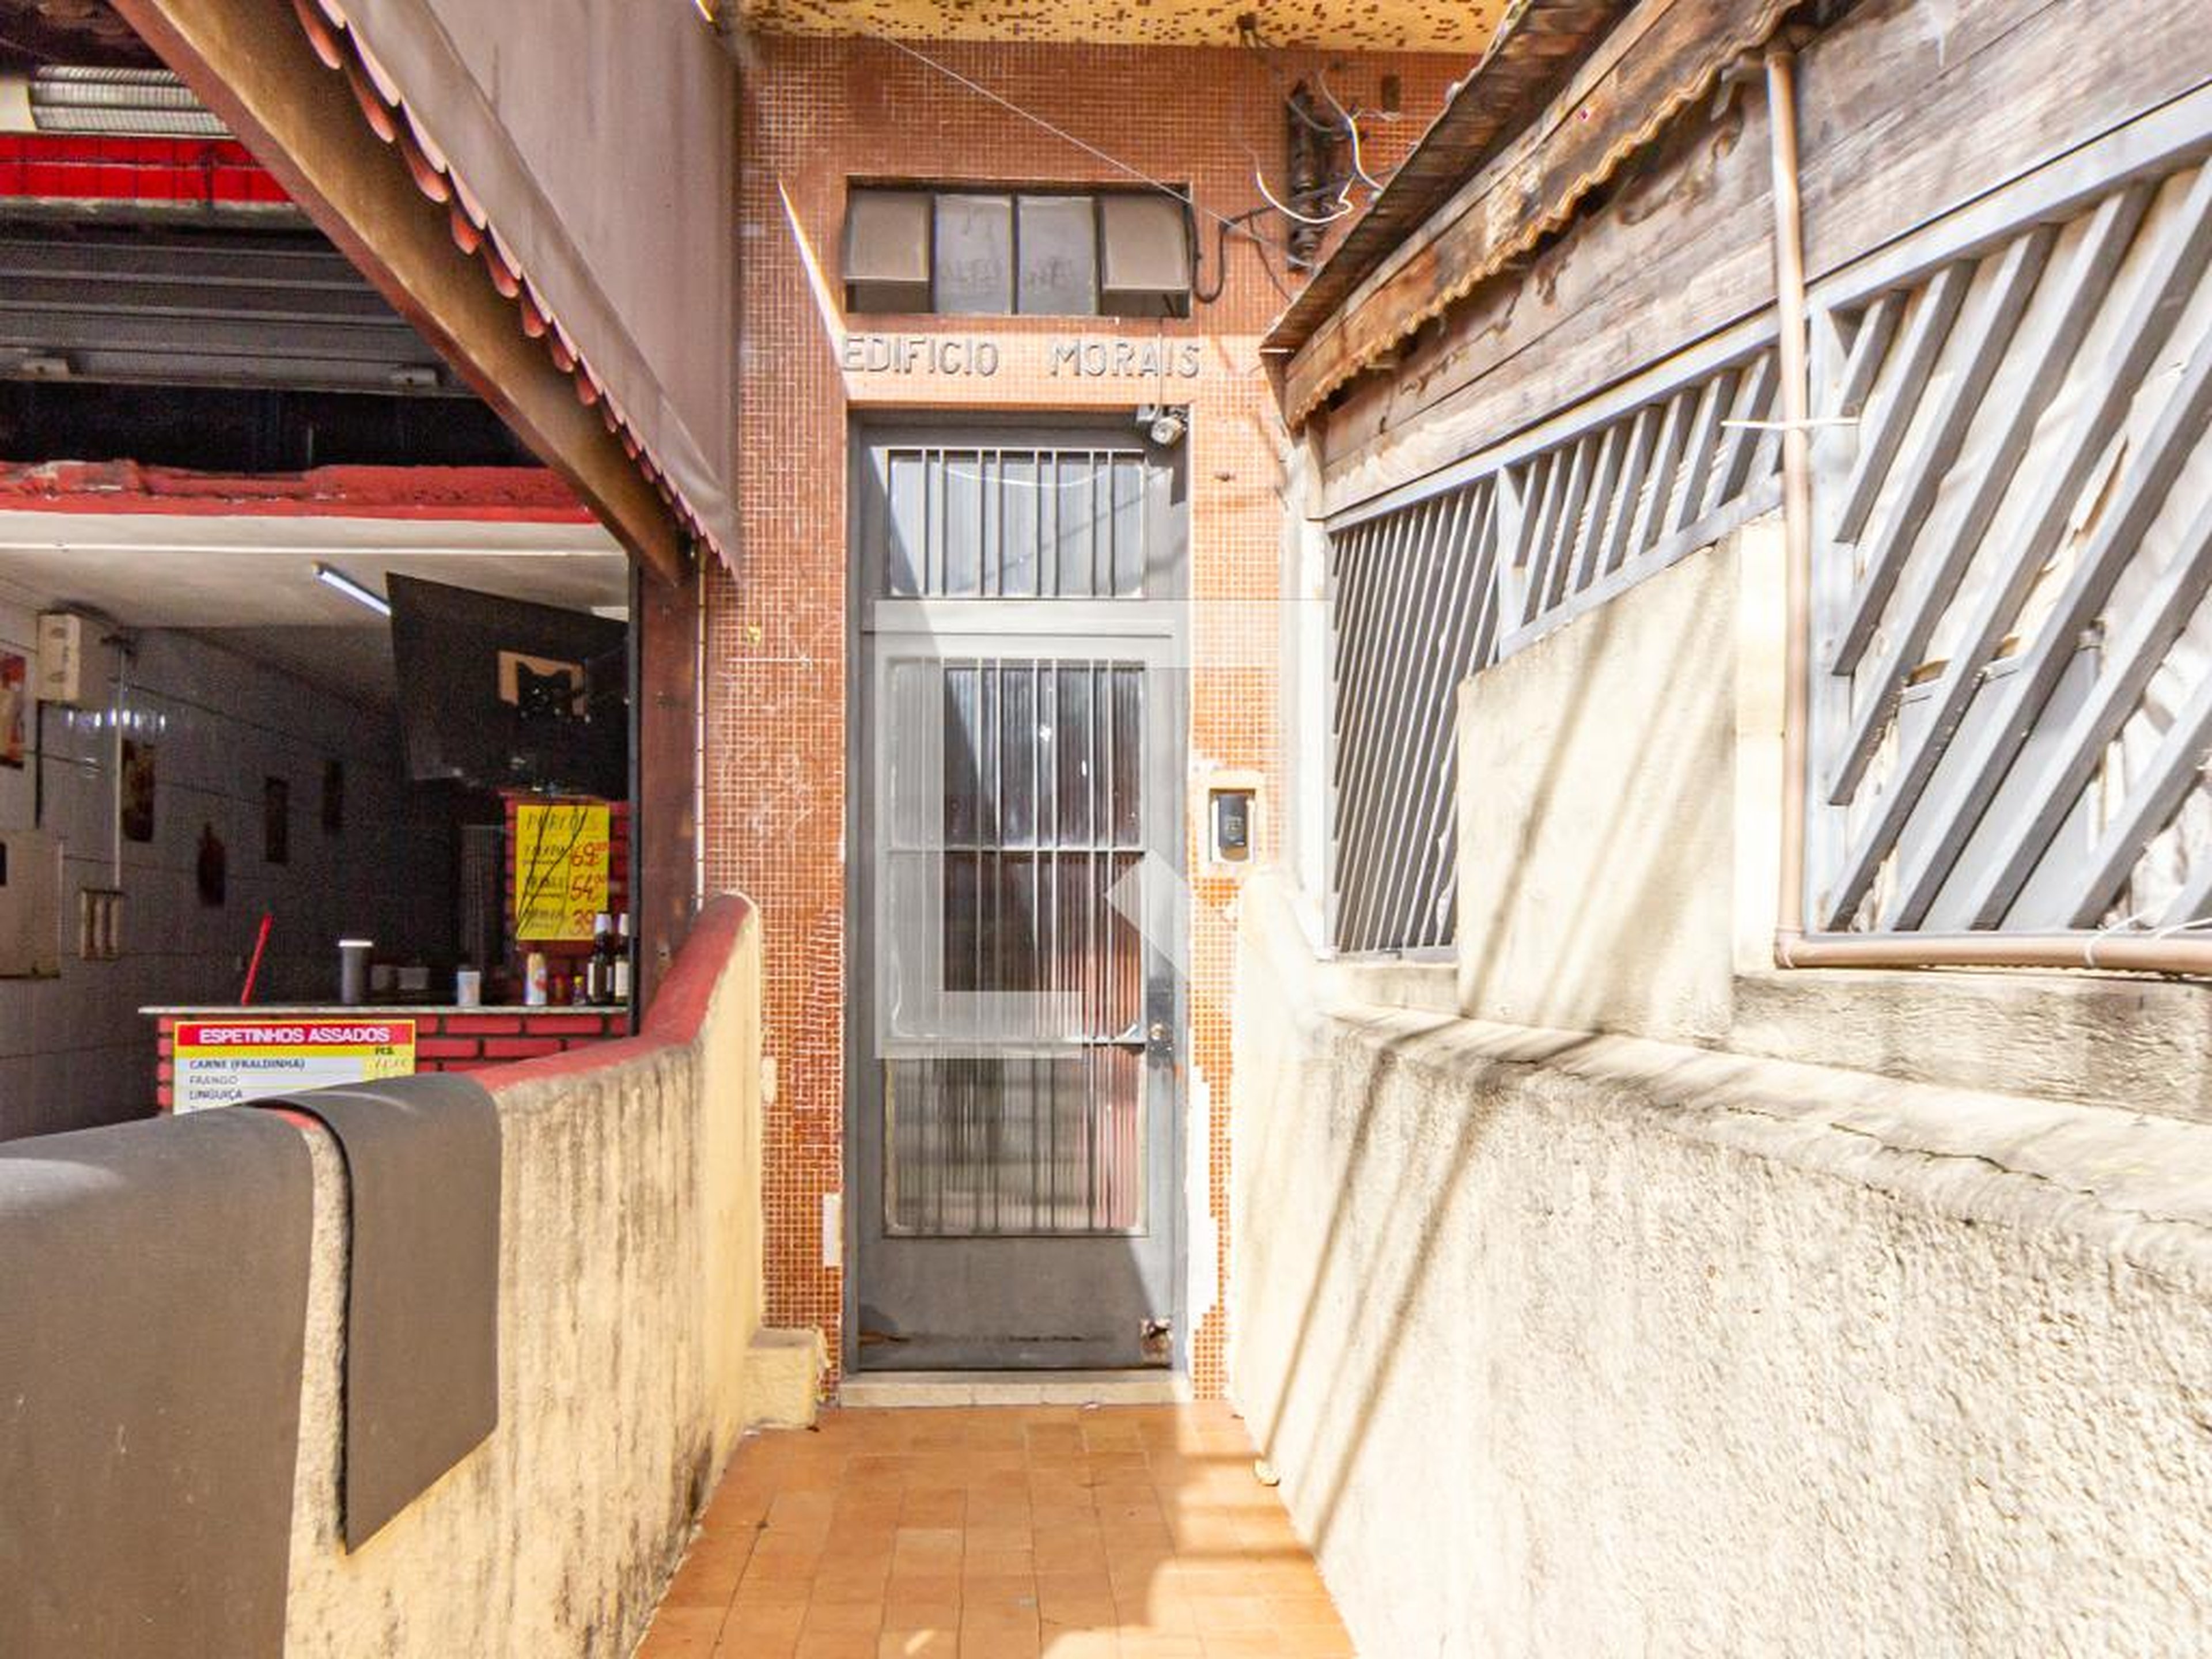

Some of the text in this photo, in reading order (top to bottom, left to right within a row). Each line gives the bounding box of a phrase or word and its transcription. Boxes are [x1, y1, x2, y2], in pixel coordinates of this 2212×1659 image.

[842, 335, 1200, 378] EDIFICIO MORAIS
[199, 1028, 390, 1044] ESPETINHOS ASSADOS
[189, 1059, 226, 1070] CARNE
[189, 1075, 238, 1085] FRANGO
